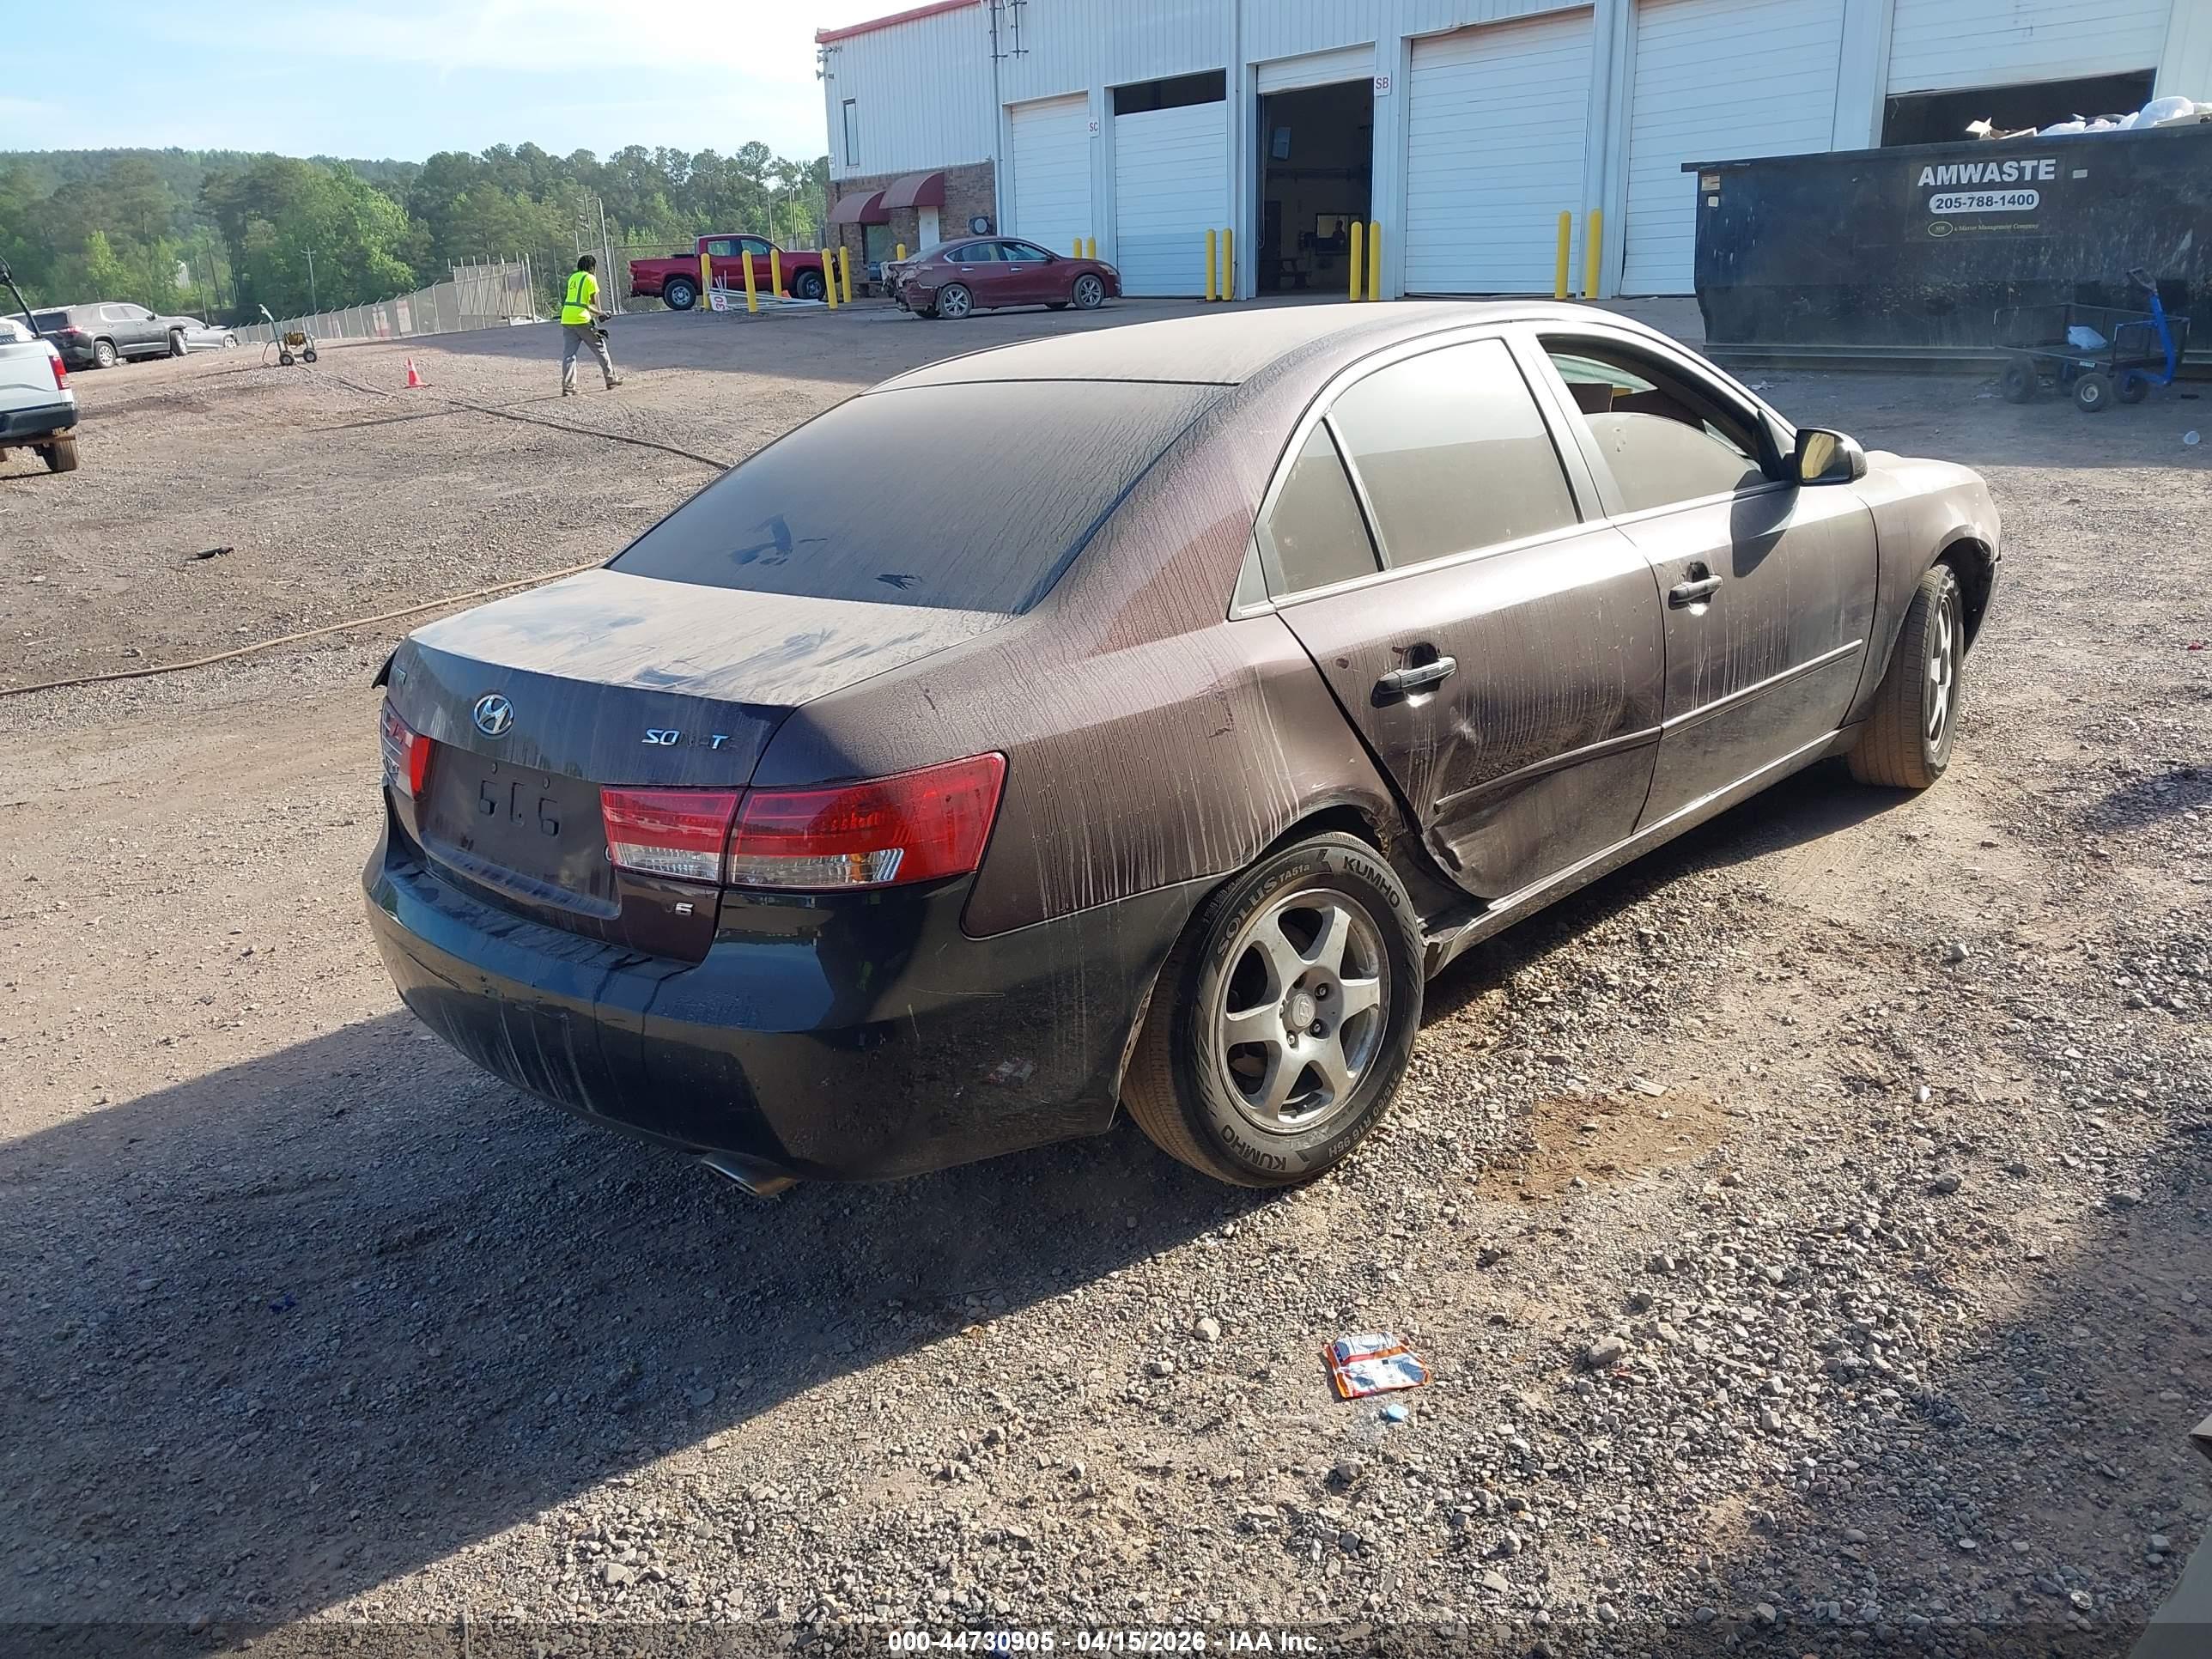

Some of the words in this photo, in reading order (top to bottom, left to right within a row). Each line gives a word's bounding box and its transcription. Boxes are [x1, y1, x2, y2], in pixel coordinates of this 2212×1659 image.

[1376, 77, 1389, 89] SB
[1089, 122, 1098, 131] SC
[1917, 159, 2057, 186] AMWASTE
[1936, 194, 2035, 210] 205-788-1400
[1343, 856, 1401, 908] KUMHO
[1217, 876, 1278, 956] SOLUS
[1221, 1124, 1287, 1170] KUMHO
